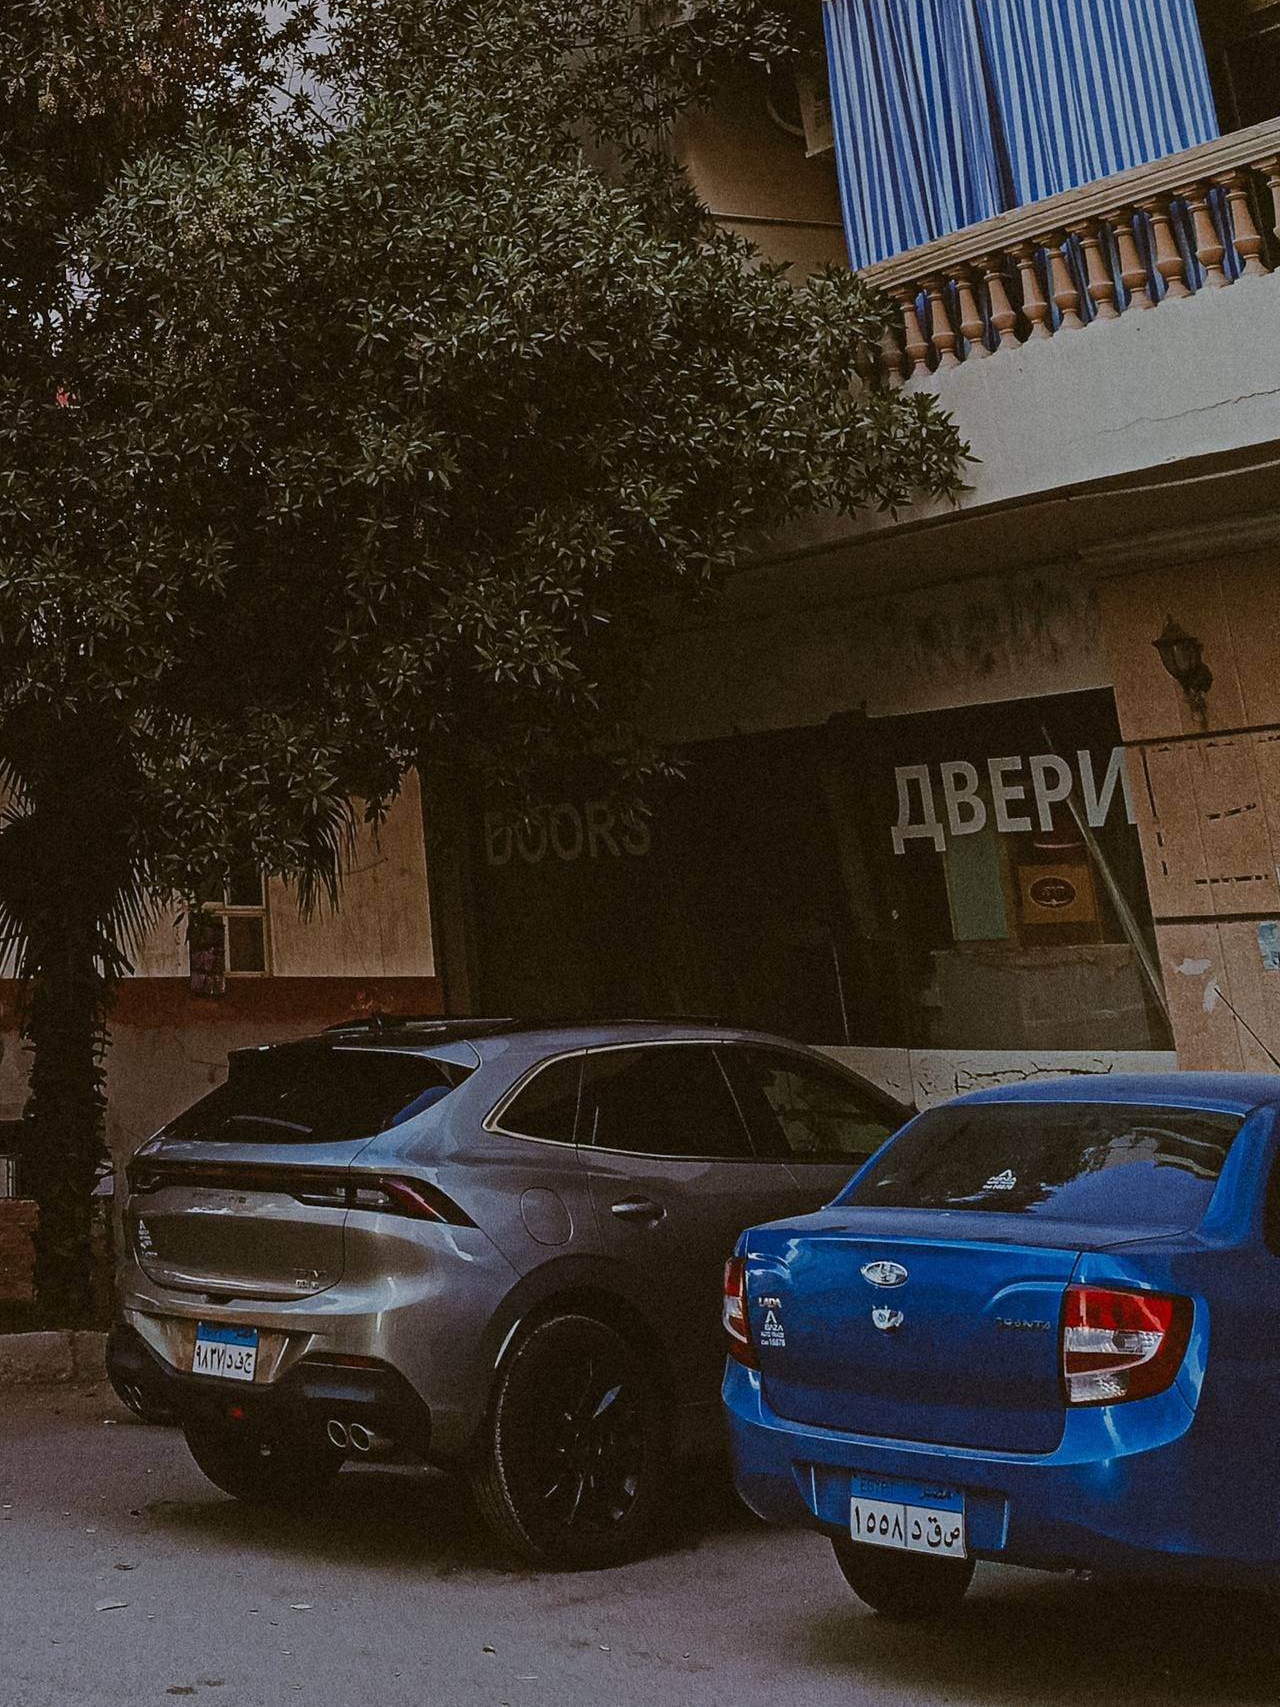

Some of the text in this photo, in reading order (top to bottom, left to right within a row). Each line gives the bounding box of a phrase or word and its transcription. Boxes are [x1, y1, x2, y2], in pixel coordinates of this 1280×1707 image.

[891, 746, 1138, 855] ДВЕРИ
[483, 797, 652, 866] DOORS
[758, 1297, 783, 1308] LADA
[994, 1316, 1052, 1331] GRANTA
[860, 1477, 896, 1497] EGYPT
[854, 1505, 904, 1542] ١٥٥٨
